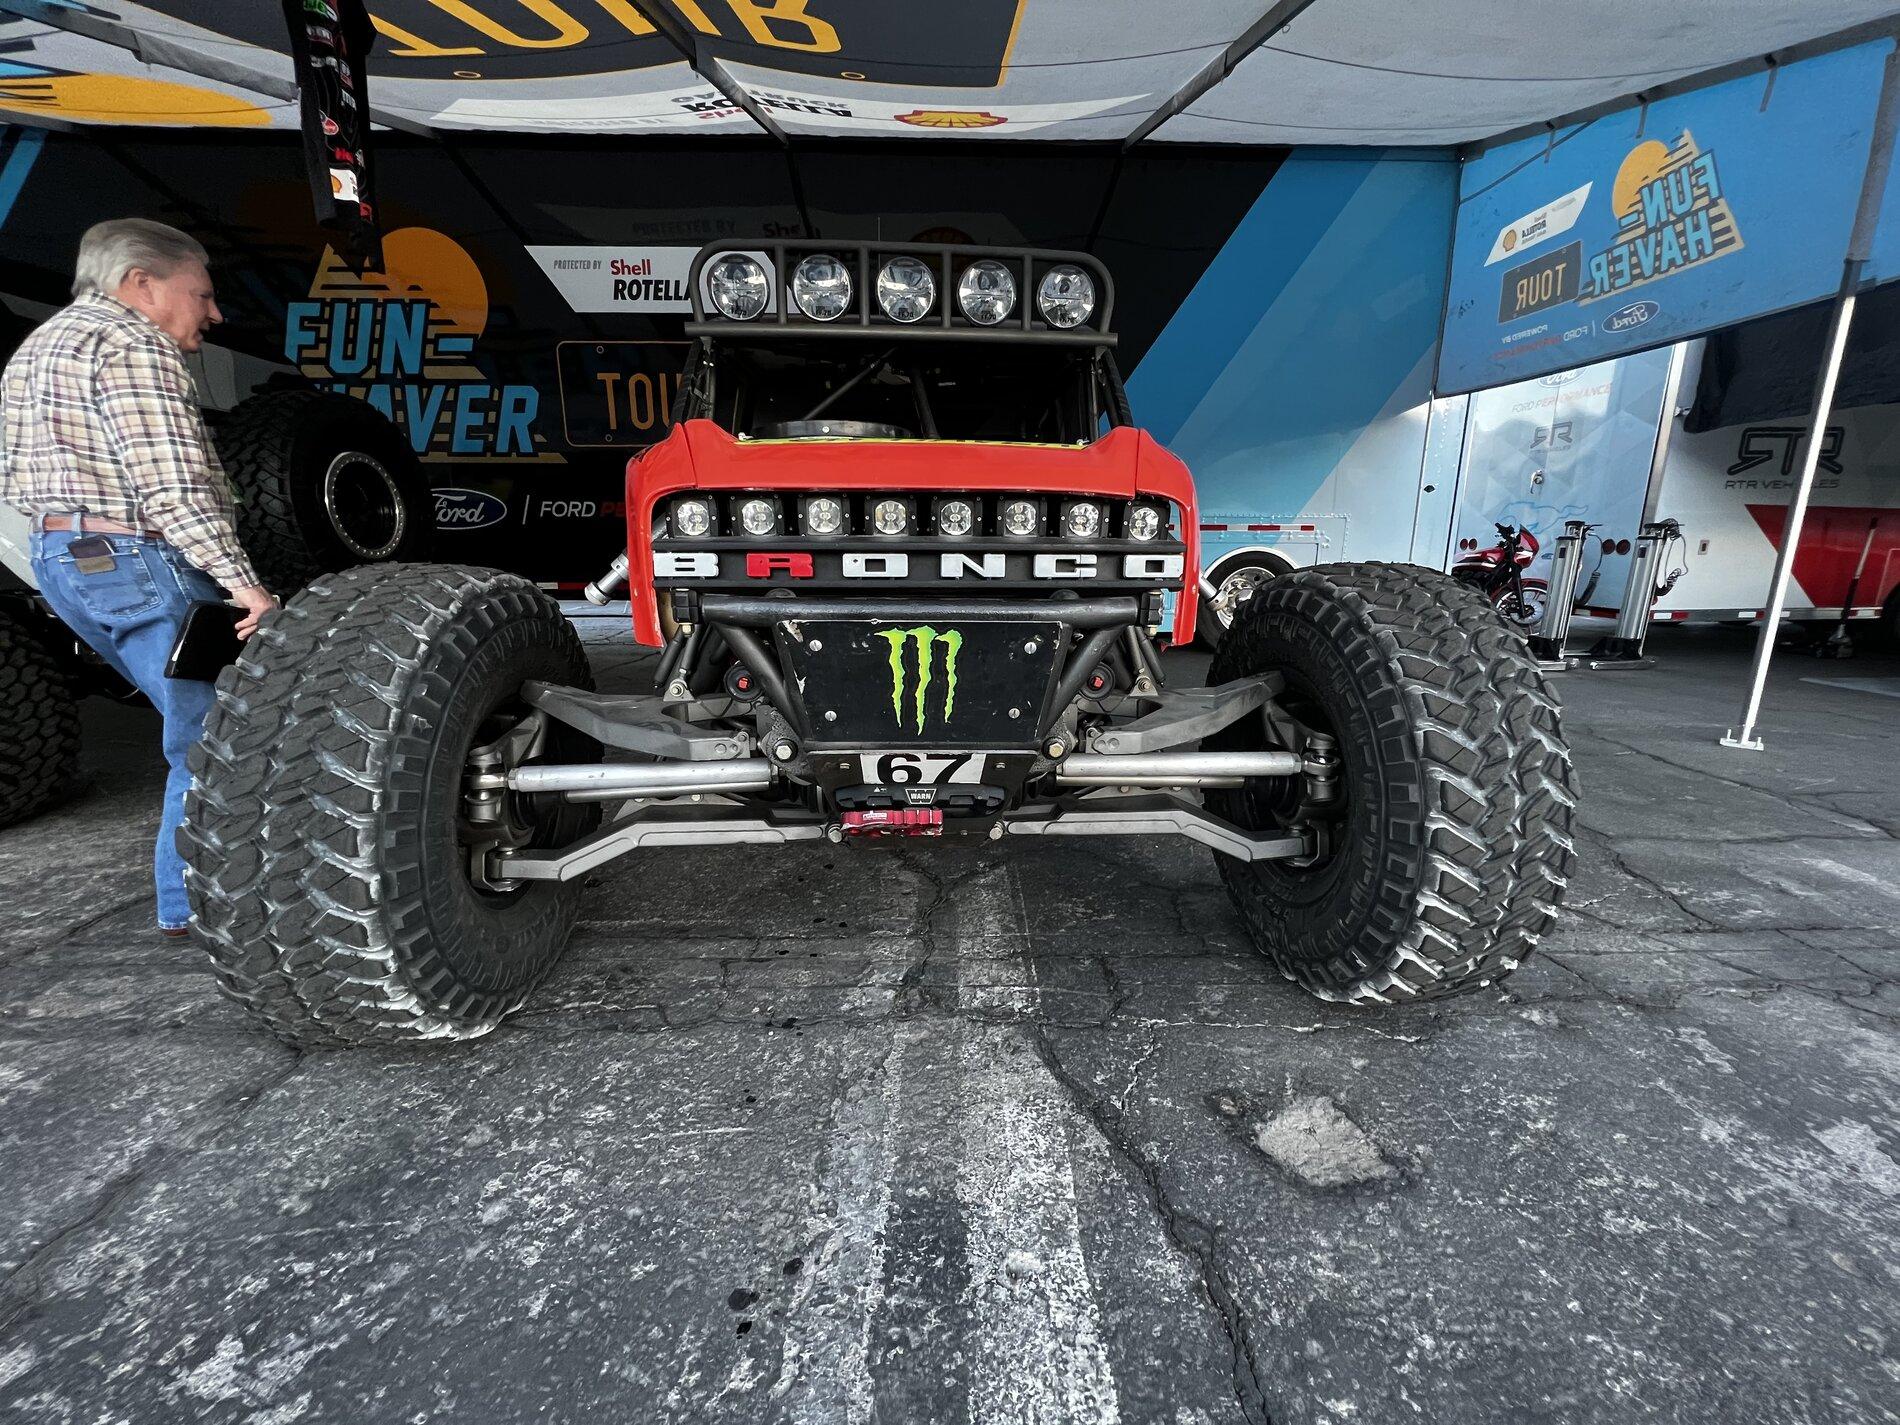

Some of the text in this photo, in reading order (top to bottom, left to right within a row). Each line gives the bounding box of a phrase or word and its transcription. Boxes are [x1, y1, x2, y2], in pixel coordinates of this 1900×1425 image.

[553, 260, 602, 270] PROTECTED BY
[610, 258, 651, 275] Shell
[1725, 480, 1758, 490] RTR
[540, 501, 596, 518] FORD
[653, 552, 1184, 578] BRONCO
[876, 753, 973, 784] 67
[910, 792, 931, 800] WARN
